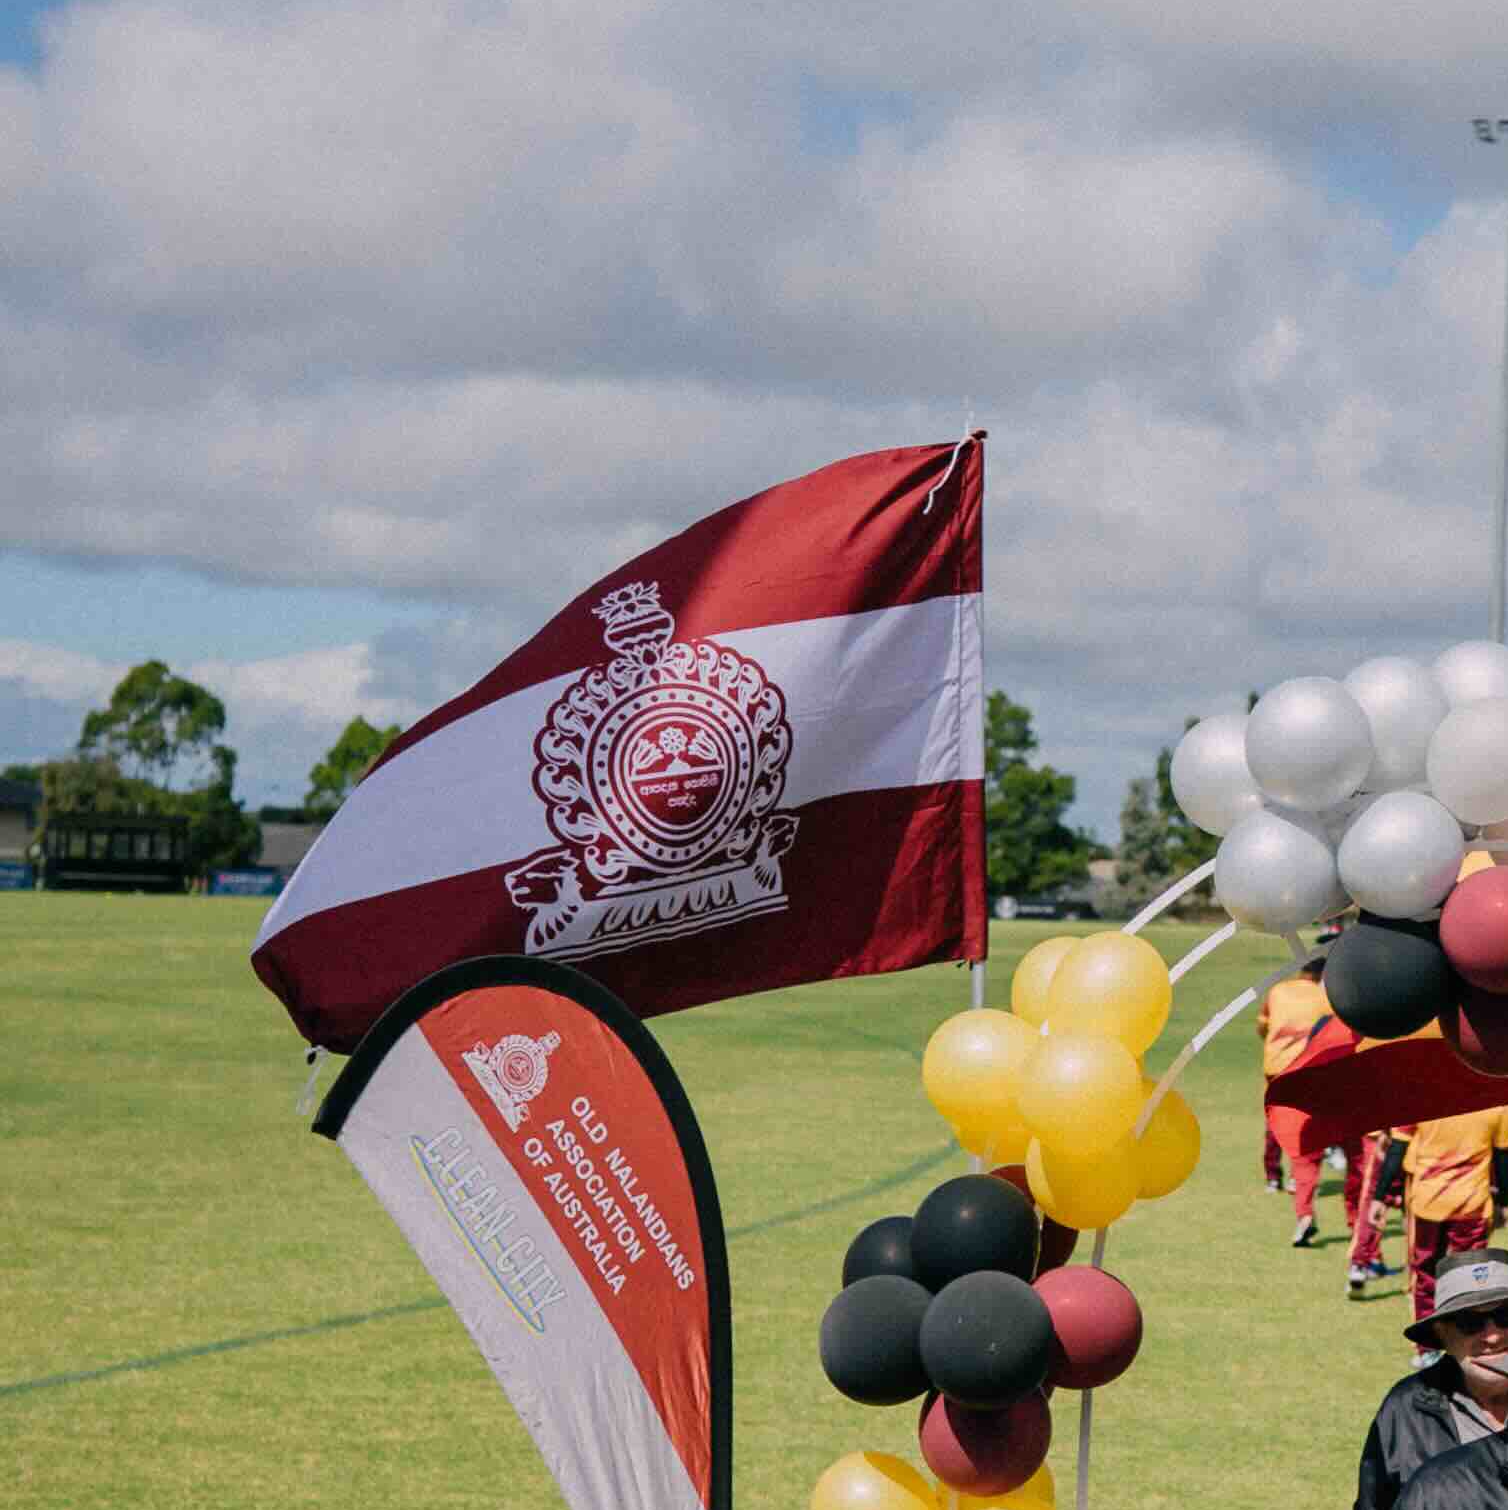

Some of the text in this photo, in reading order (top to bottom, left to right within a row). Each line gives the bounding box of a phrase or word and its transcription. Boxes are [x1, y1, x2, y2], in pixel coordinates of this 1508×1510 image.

[426, 1129, 567, 1314] CLEAN CITY
[524, 1138, 627, 1294] OF AUSTRALIA
[547, 1120, 645, 1263] ASSOCIATION
[572, 1097, 694, 1290] OLD NALANDIANS
